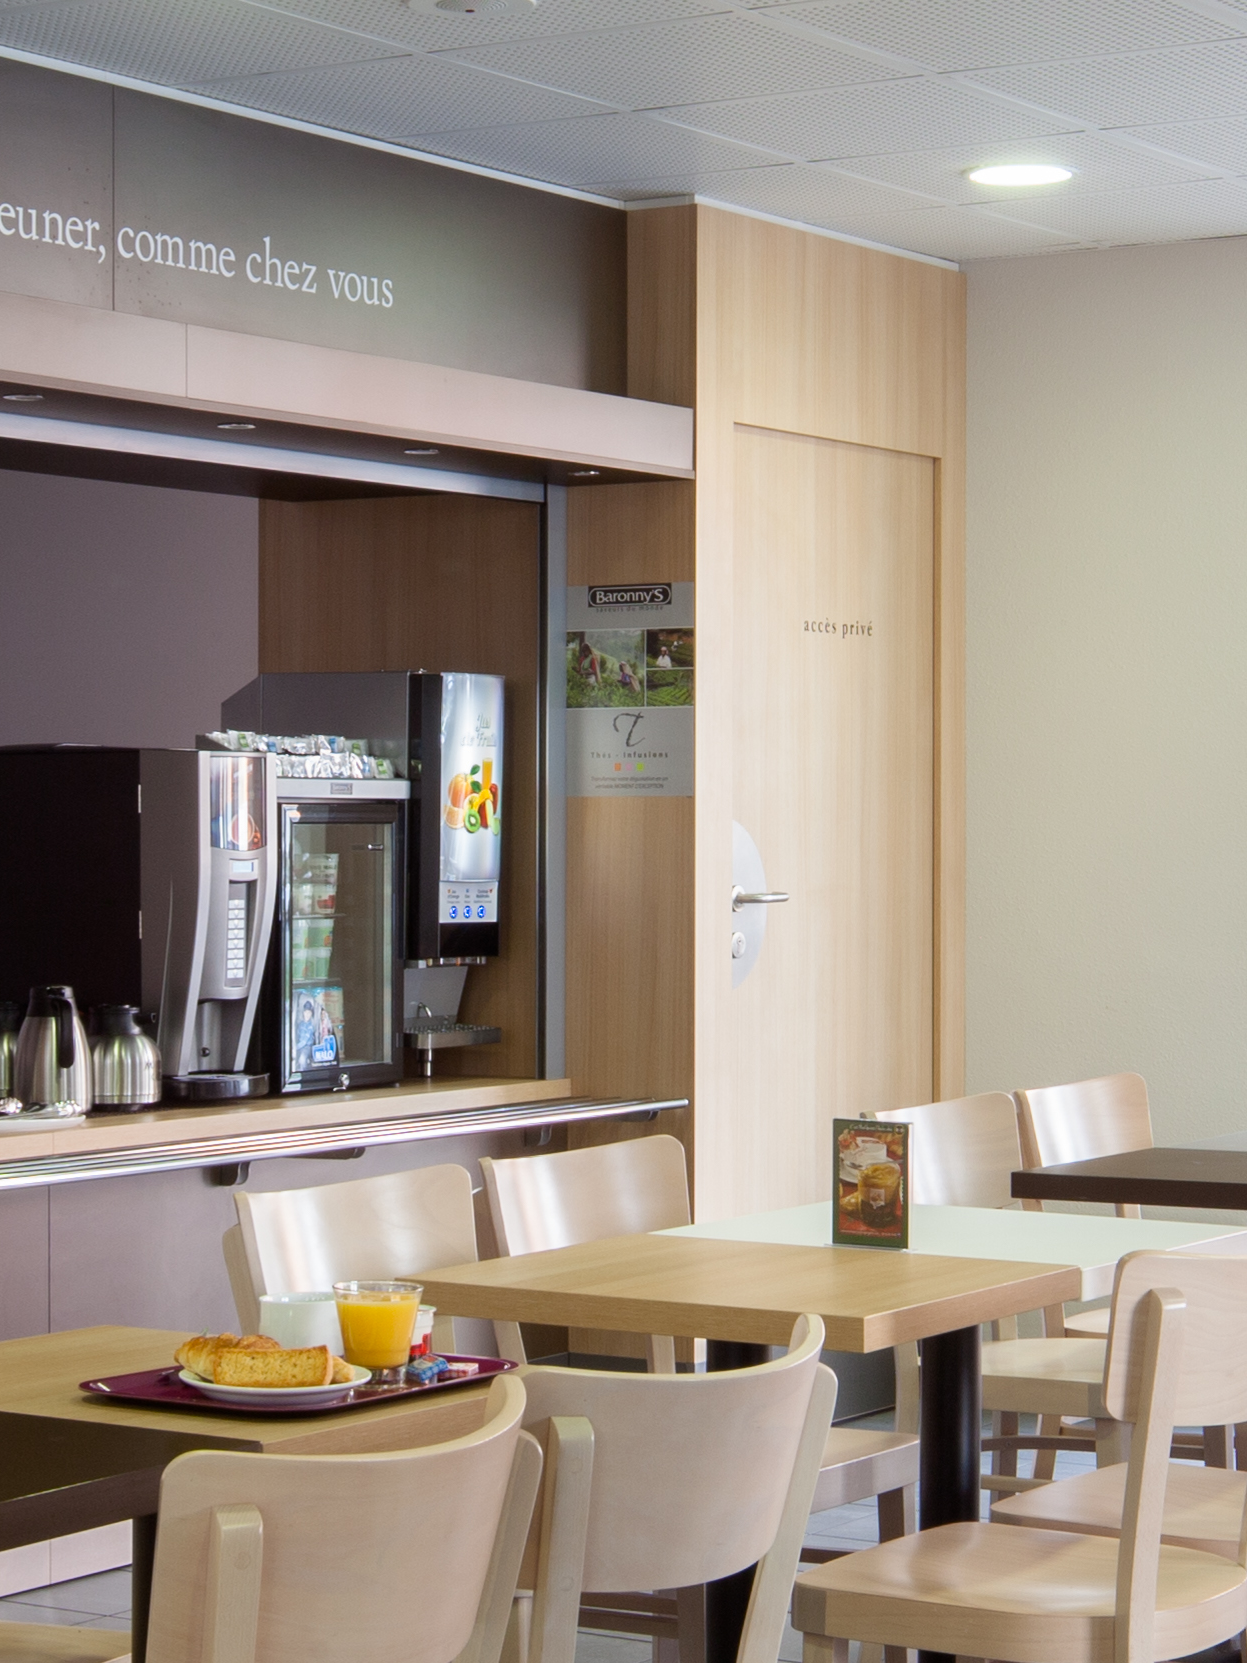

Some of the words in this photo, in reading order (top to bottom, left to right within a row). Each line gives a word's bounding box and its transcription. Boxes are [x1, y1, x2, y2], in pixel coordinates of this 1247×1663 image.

[117, 225, 236, 279] comme
[245, 237, 318, 294] chez
[327, 268, 394, 308] vous
[804, 617, 837, 634] accès
[842, 620, 873, 639] privé
